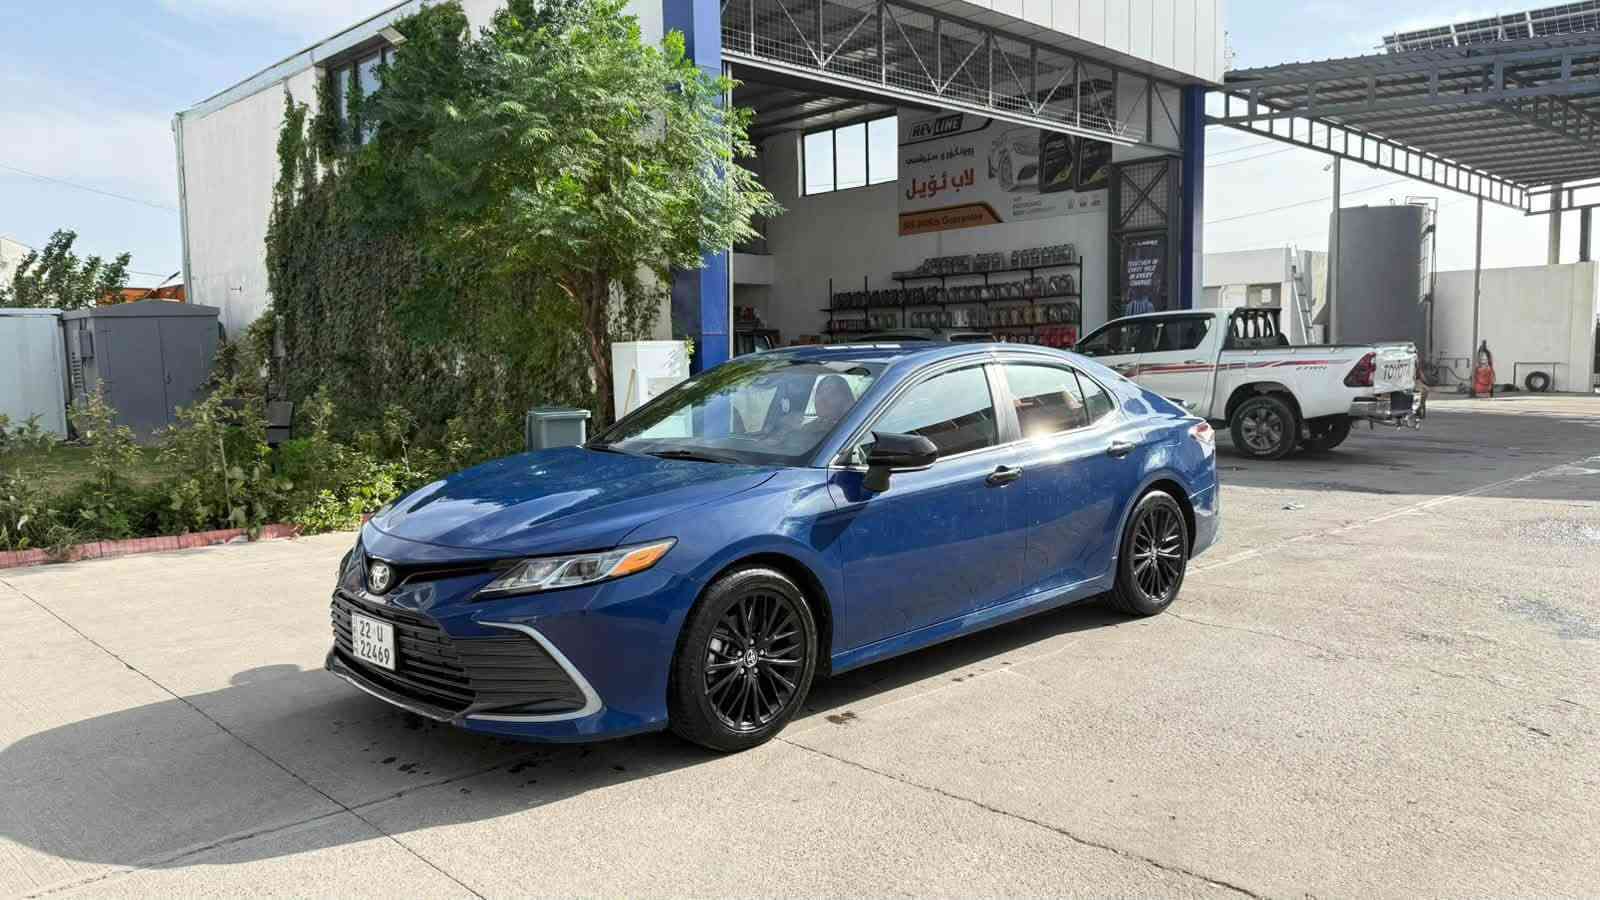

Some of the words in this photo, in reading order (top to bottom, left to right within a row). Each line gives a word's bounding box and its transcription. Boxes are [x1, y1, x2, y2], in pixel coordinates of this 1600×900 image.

[360, 620, 371, 639] 22
[377, 624, 384, 642] U
[360, 640, 390, 665] 22469
